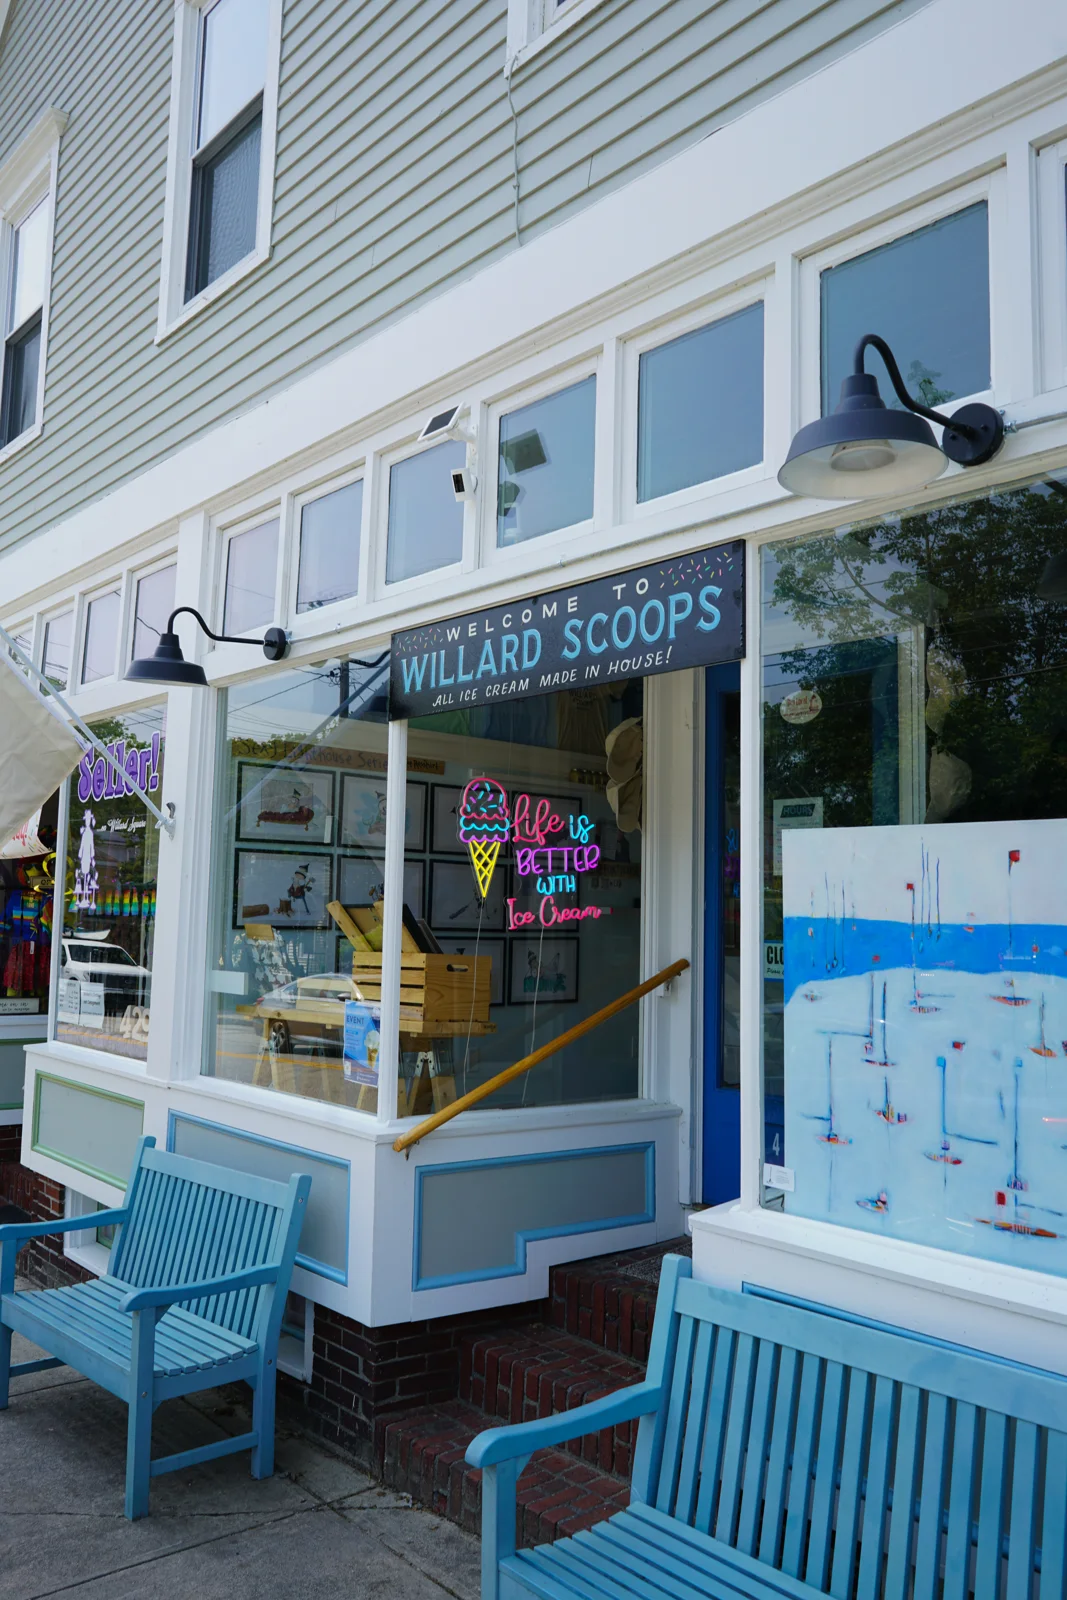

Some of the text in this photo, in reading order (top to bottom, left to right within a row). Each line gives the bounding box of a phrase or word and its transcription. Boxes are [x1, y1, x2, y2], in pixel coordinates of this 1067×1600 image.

[446, 578, 650, 642] WELCOME TO
[400, 585, 723, 695] WILLARD SCOOPS
[432, 646, 673, 707] ALL ICE CREAM MADE IN HOUSE!
[78, 731, 161, 803] Seller!
[358, 751, 389, 770] Serie
[510, 793, 595, 846] Life is
[782, 805, 814, 817] HOURS
[516, 844, 600, 876] BETTER
[536, 874, 576, 895] WITH
[506, 895, 602, 930] Ice Cream
[767, 945, 784, 965] CLO
[346, 1015, 365, 1024] EVENT
